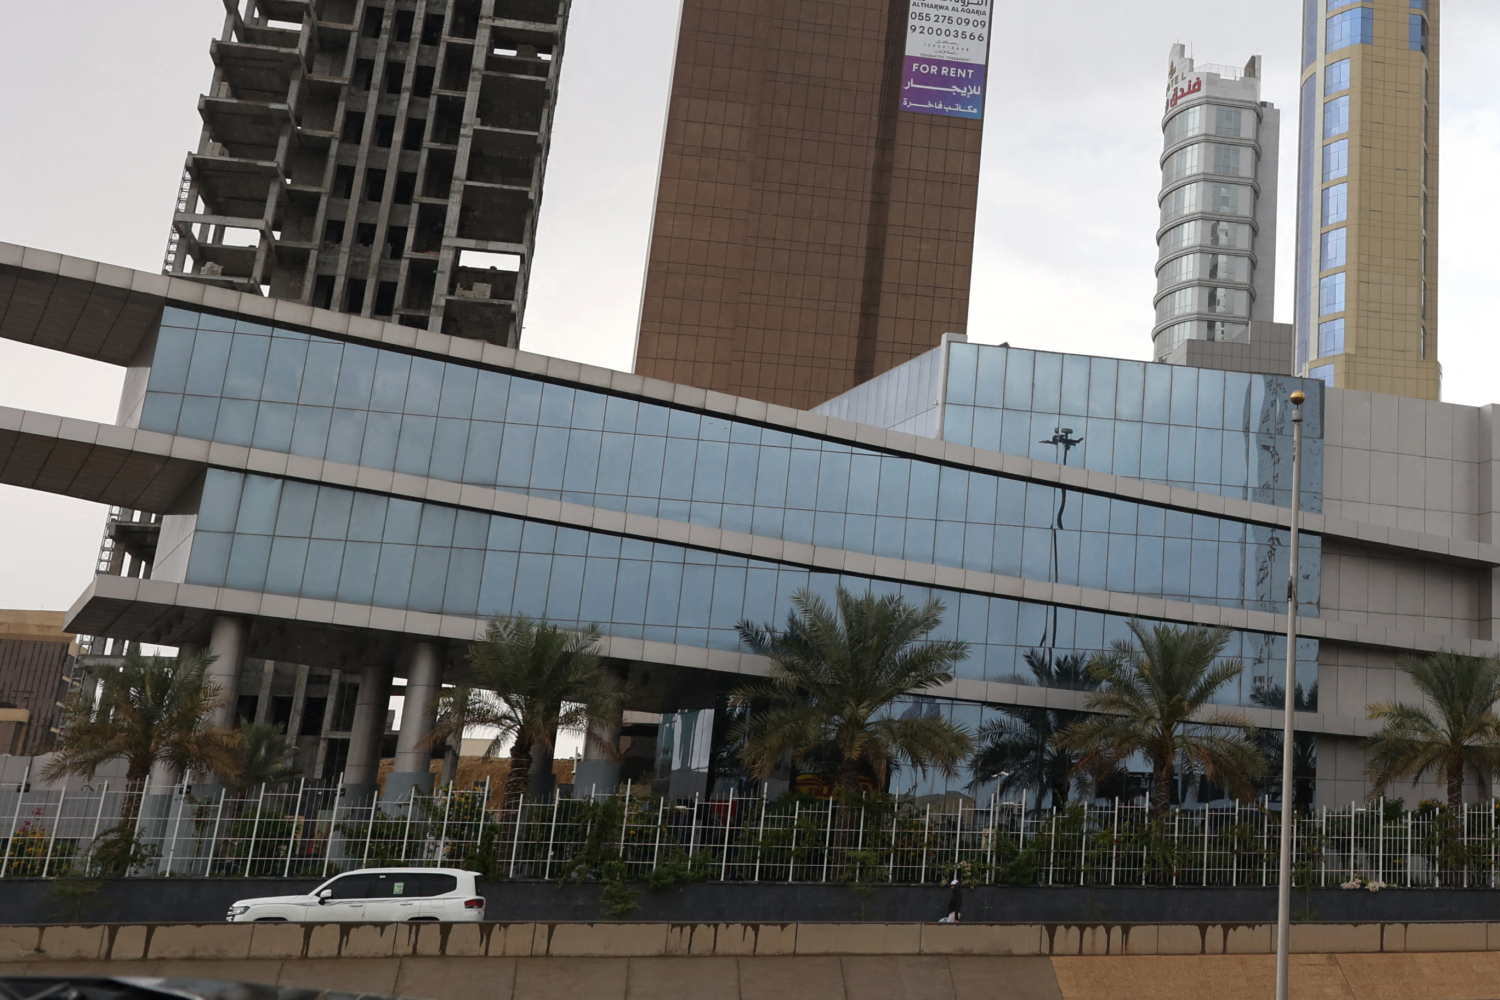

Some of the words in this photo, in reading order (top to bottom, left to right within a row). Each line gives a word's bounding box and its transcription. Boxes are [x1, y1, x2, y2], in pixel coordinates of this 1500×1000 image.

[912, 2, 950, 11] ALTHARWA
[910, 12, 931, 22] 055
[934, 14, 954, 24] 275
[912, 63, 938, 74] FOR
[942, 66, 974, 79] RENT
[903, 78, 981, 98] للإيجار
[1170, 77, 1202, 108] فندق
[903, 98, 943, 109] فاخرة
[944, 103, 978, 114] مكاتب
